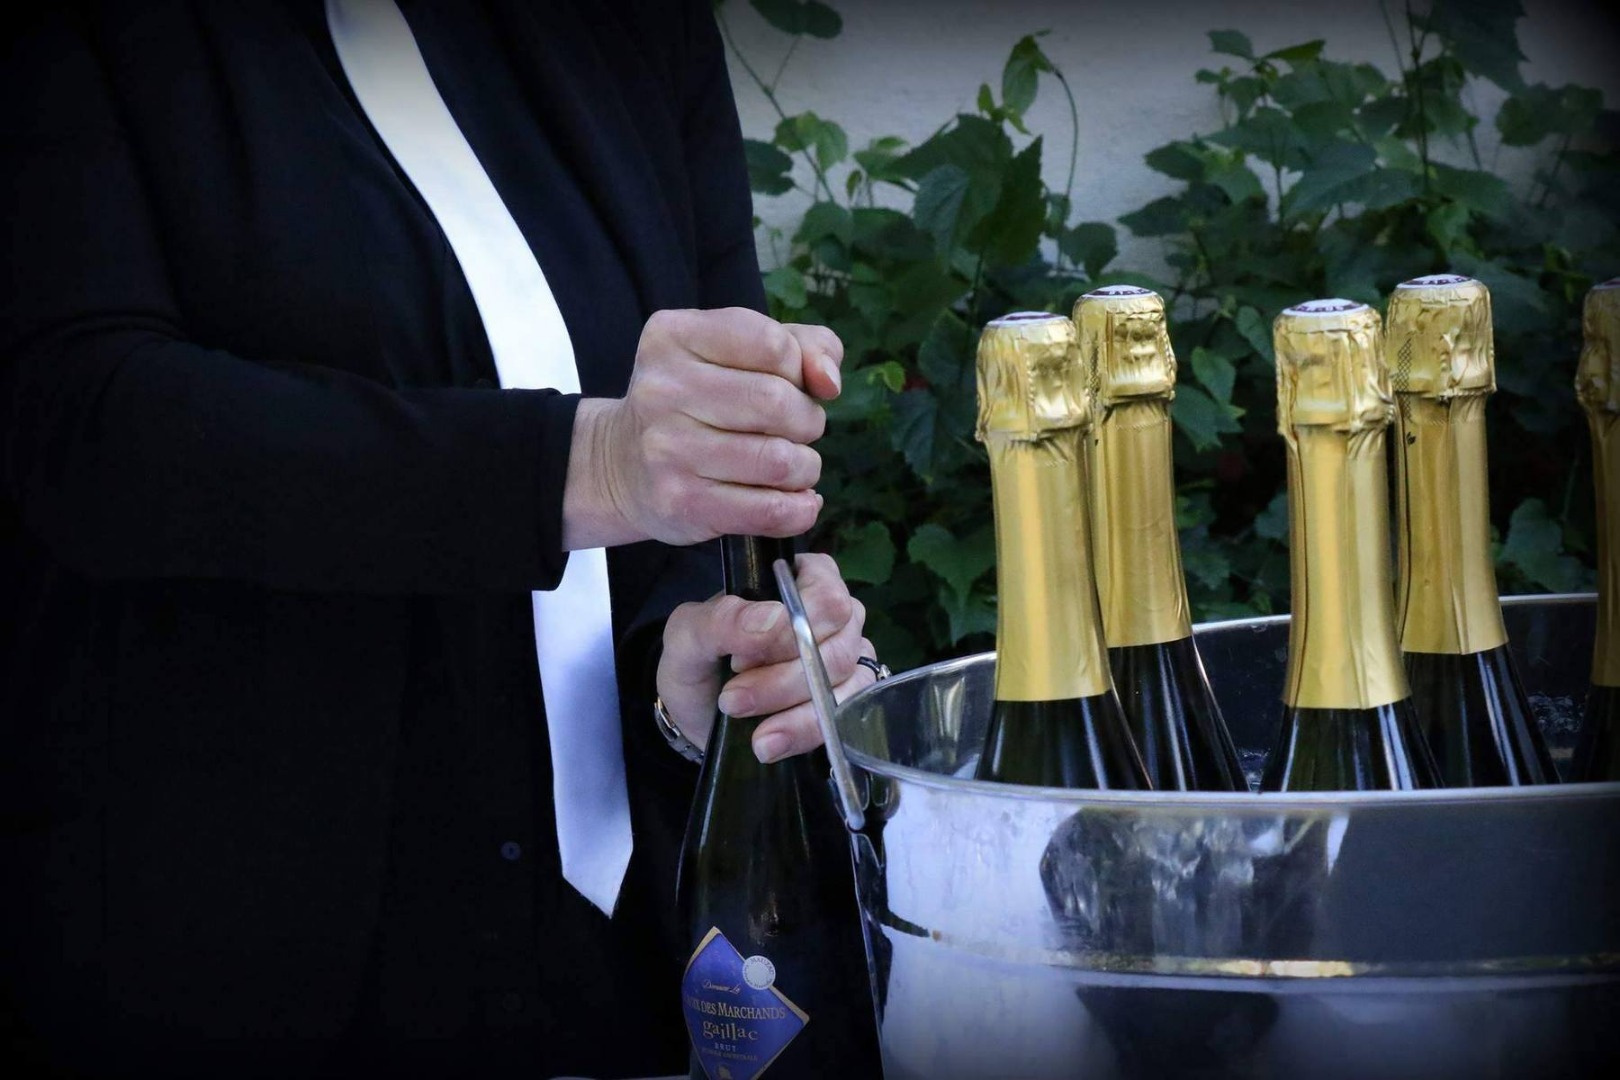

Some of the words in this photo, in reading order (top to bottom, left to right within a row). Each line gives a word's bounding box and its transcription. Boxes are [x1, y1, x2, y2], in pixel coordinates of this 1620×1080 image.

[701, 1001, 716, 1014] DES
[718, 1002, 785, 1019] MARCHANDS
[703, 1020, 758, 1040] gaillac
[714, 1042, 737, 1052] BRUT
